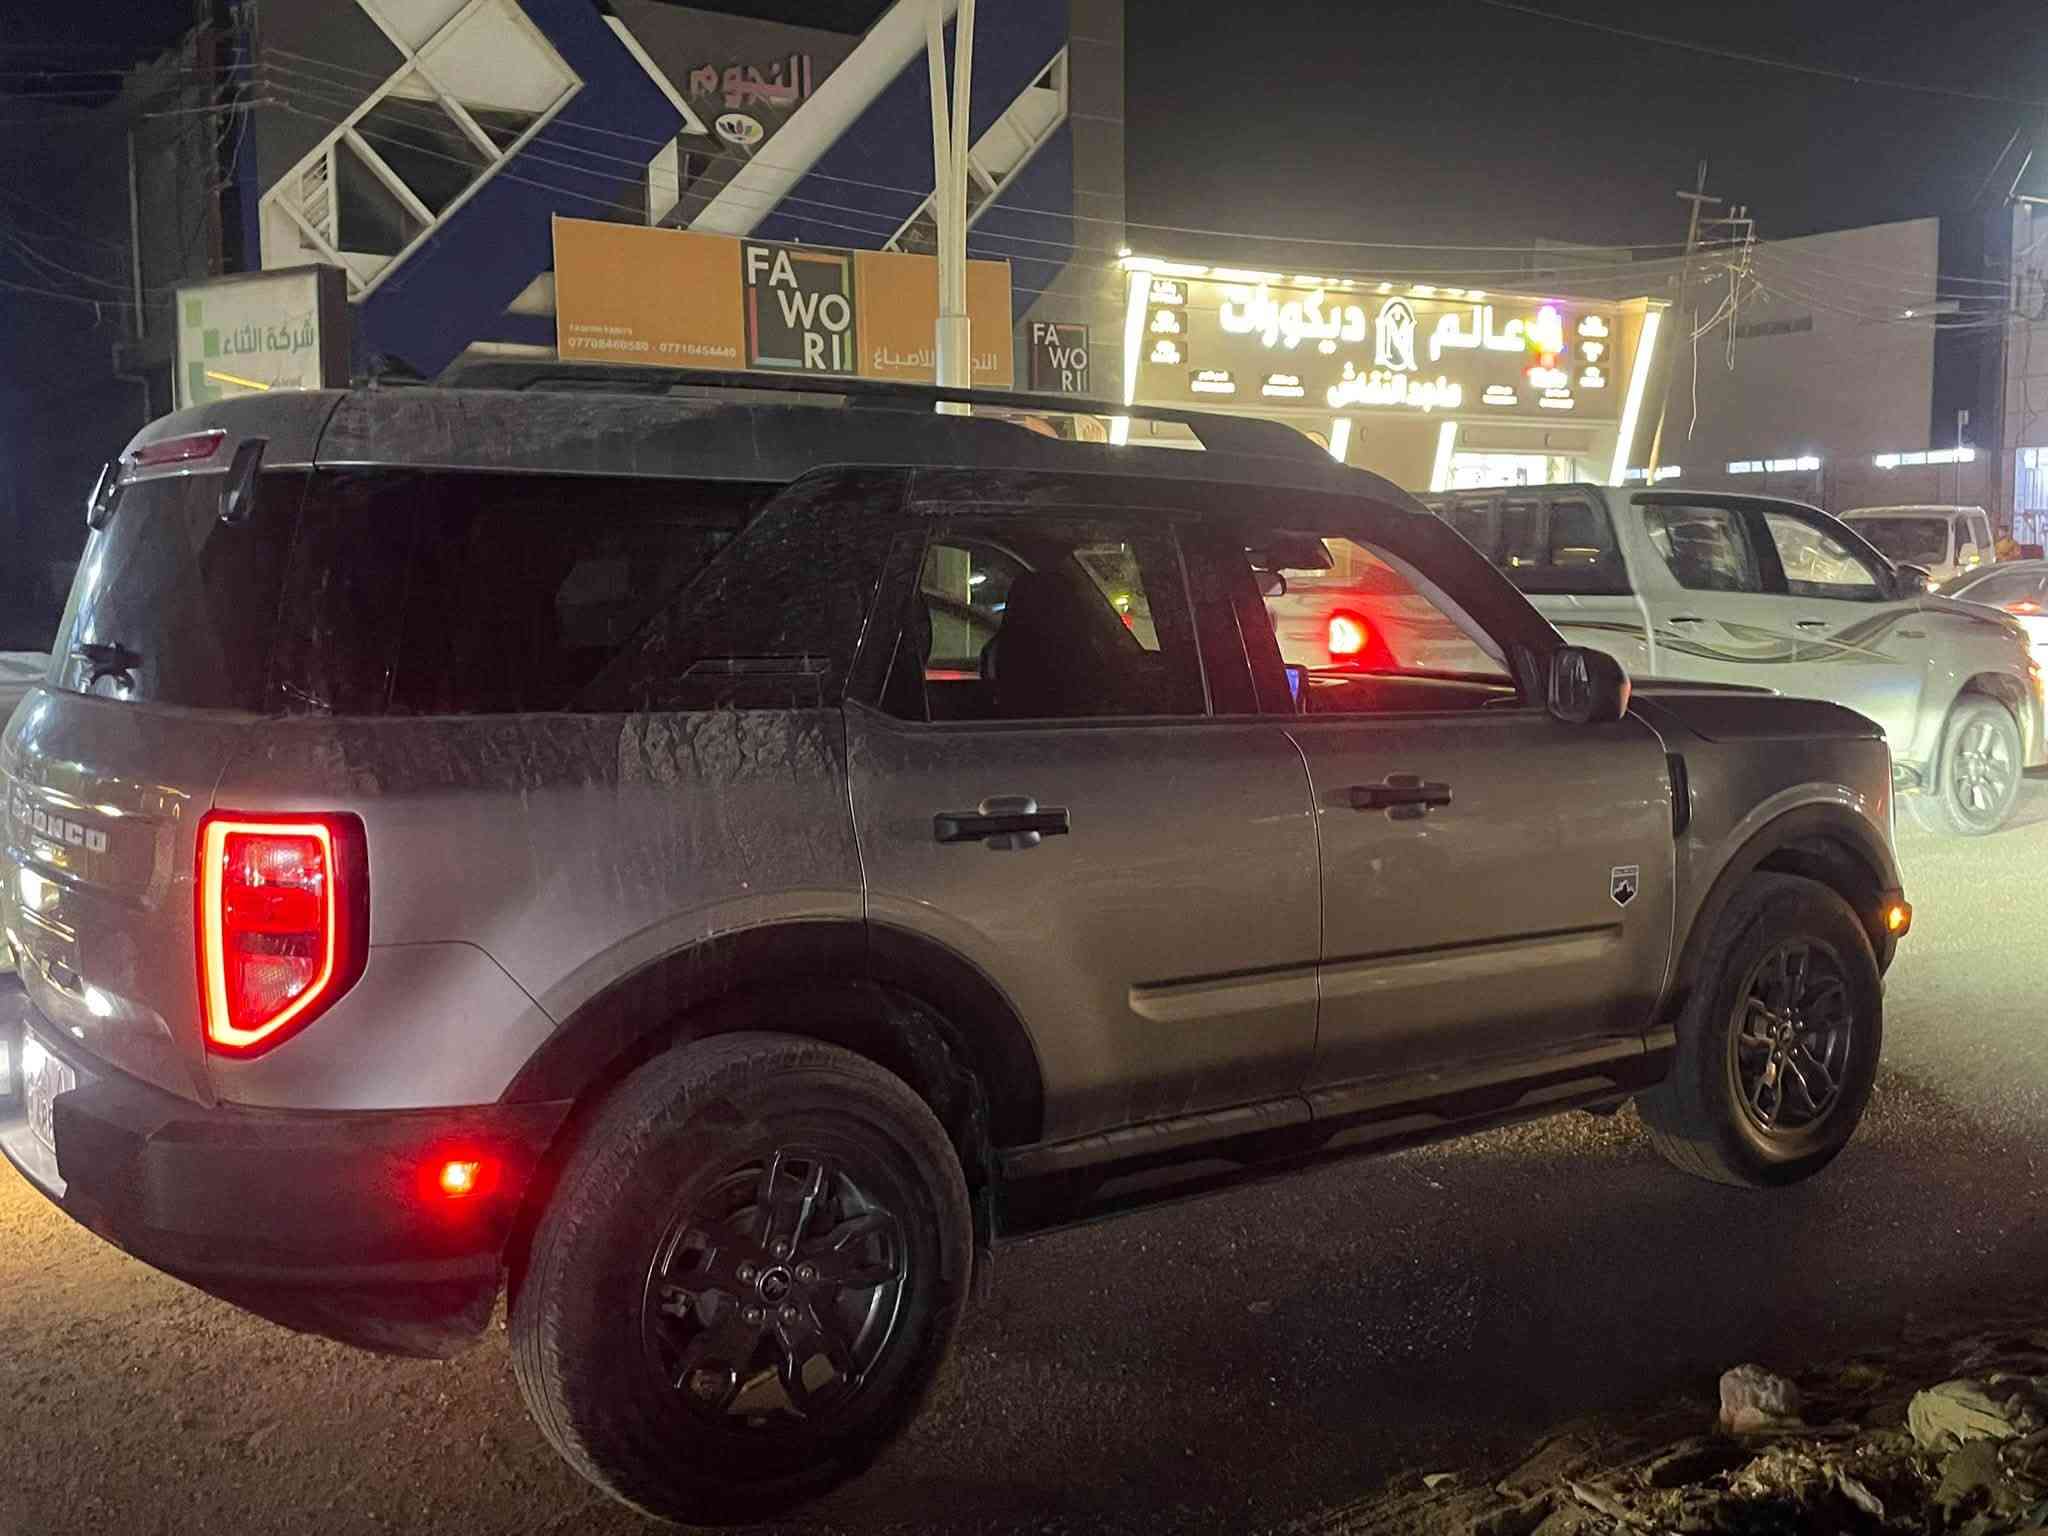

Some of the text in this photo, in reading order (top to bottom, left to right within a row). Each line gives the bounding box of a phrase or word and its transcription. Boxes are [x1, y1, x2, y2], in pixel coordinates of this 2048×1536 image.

[690, 55, 812, 109] النجوم
[747, 246, 798, 288] FA
[777, 289, 850, 332] WO
[266, 319, 315, 354] شركة
[804, 332, 841, 370] RI
[1033, 323, 1060, 346] FA
[1048, 346, 1088, 370] WO
[1062, 369, 1081, 392] RI
